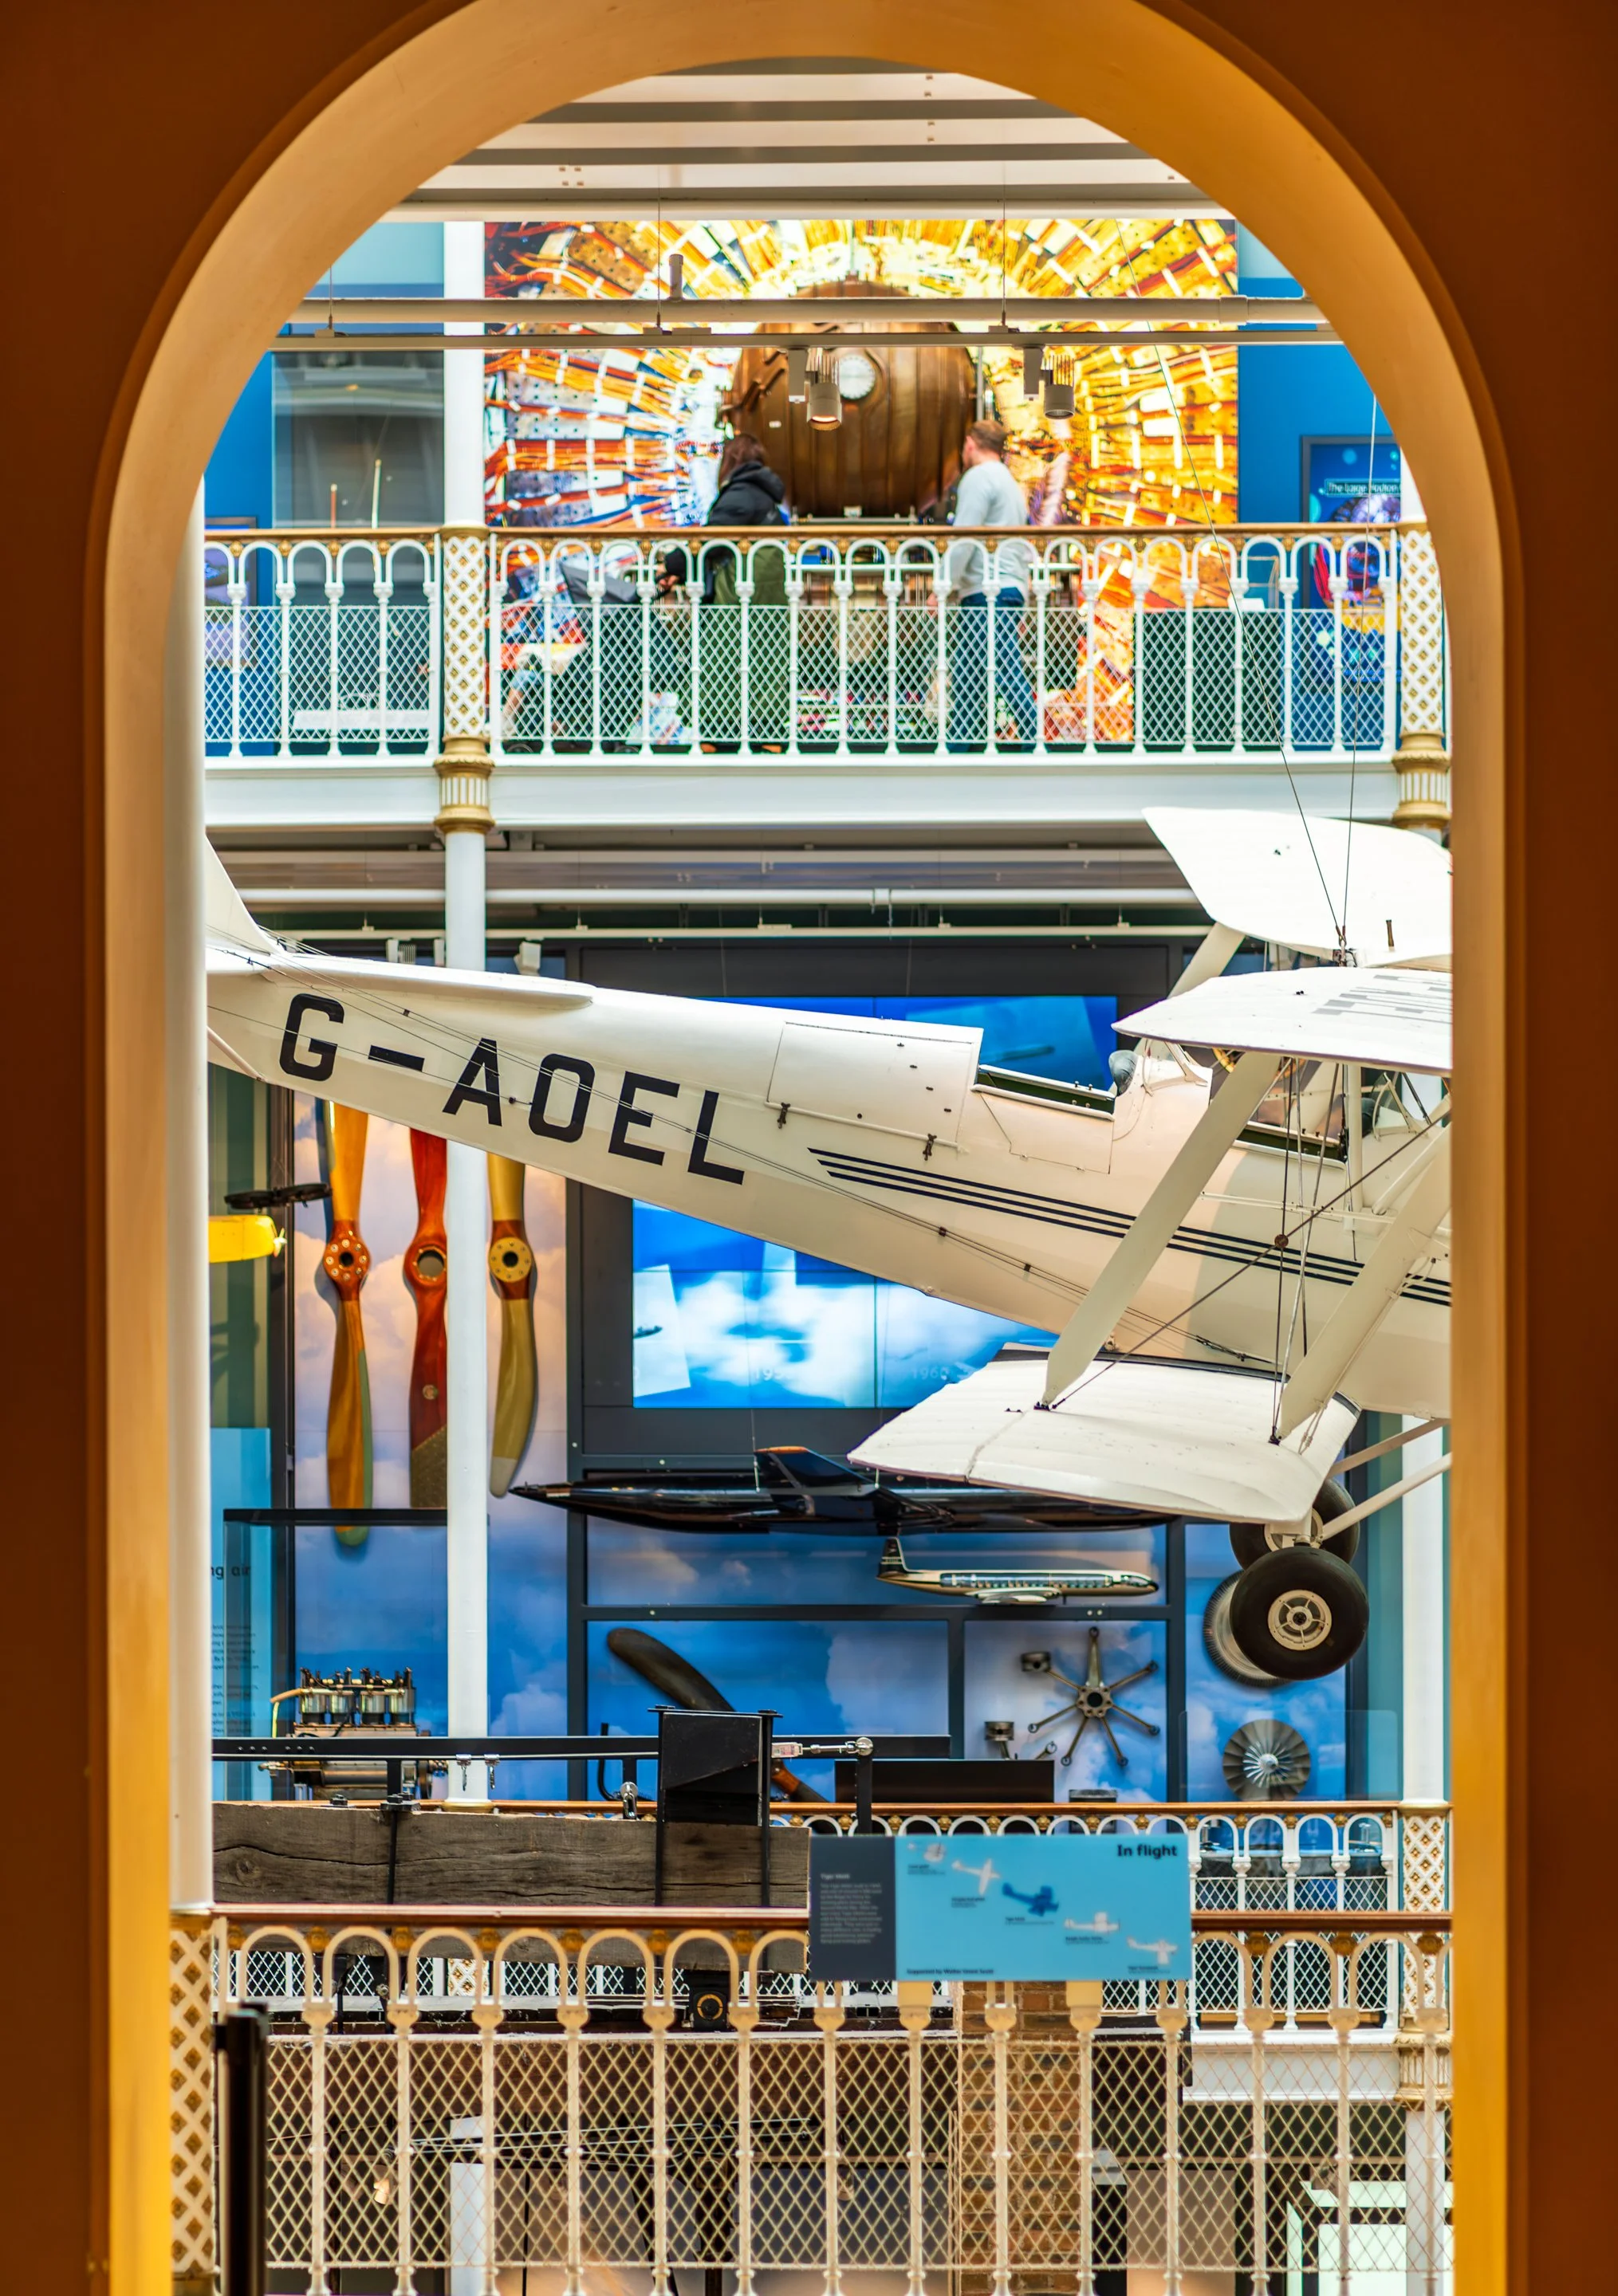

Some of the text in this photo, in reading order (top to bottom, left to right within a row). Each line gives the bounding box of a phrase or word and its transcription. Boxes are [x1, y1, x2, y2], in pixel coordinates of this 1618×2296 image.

[279, 993, 745, 1185] G-AOEL
[1117, 1843, 1178, 1860] In flight
